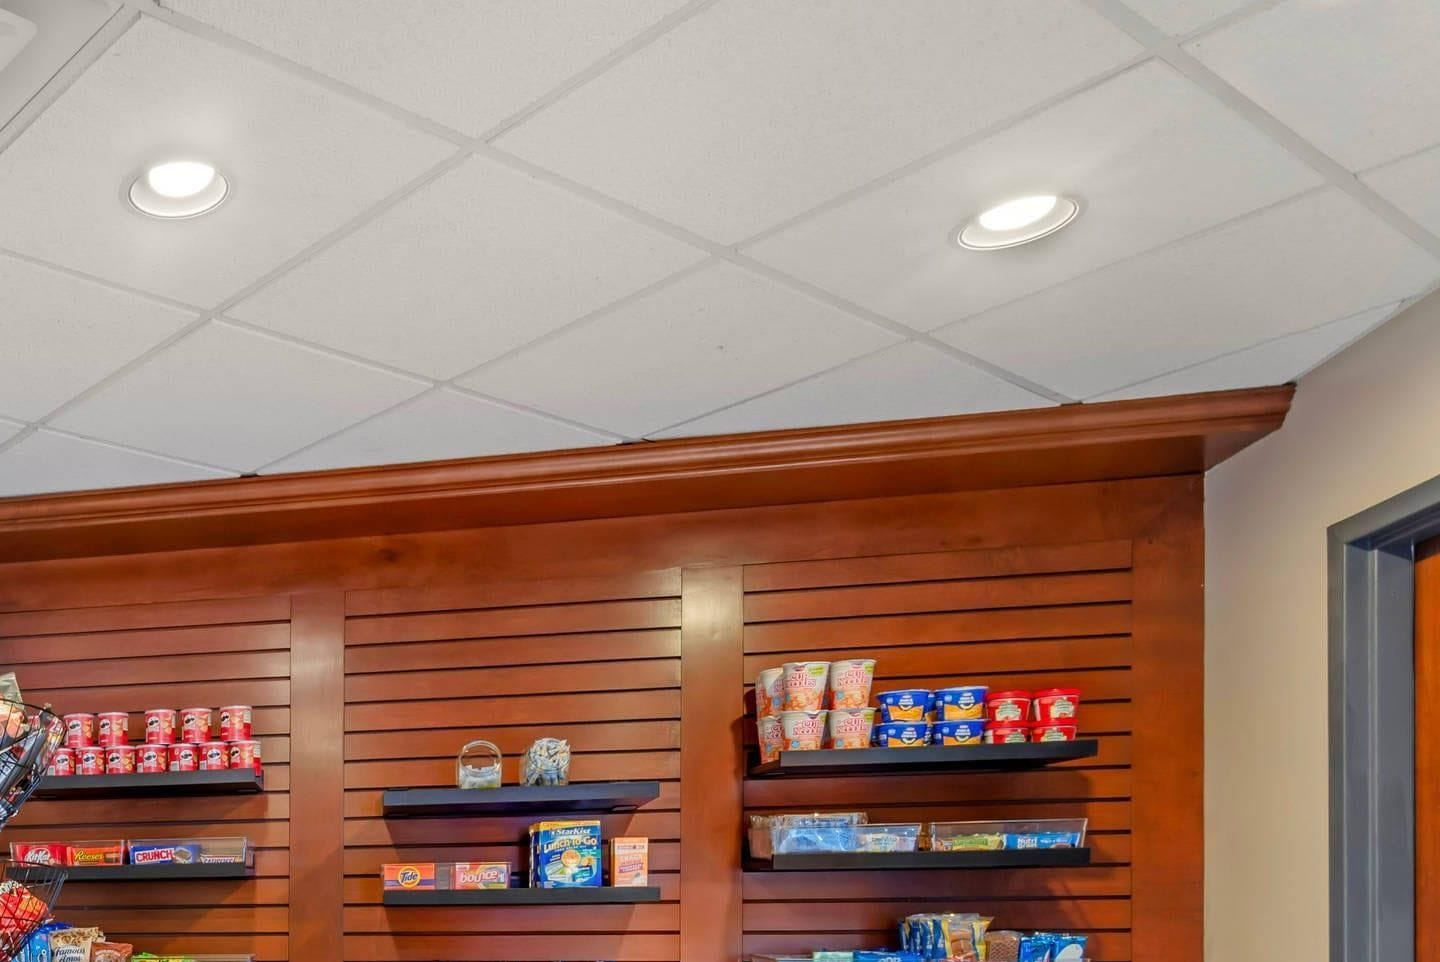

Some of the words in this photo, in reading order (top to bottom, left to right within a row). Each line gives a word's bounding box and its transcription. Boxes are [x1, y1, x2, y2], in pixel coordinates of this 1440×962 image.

[557, 827, 592, 837] StarKist
[135, 849, 175, 863] CRUNCH
[400, 870, 418, 882] Tide
[461, 869, 498, 883] bounce
[55, 947, 86, 957] Famous
